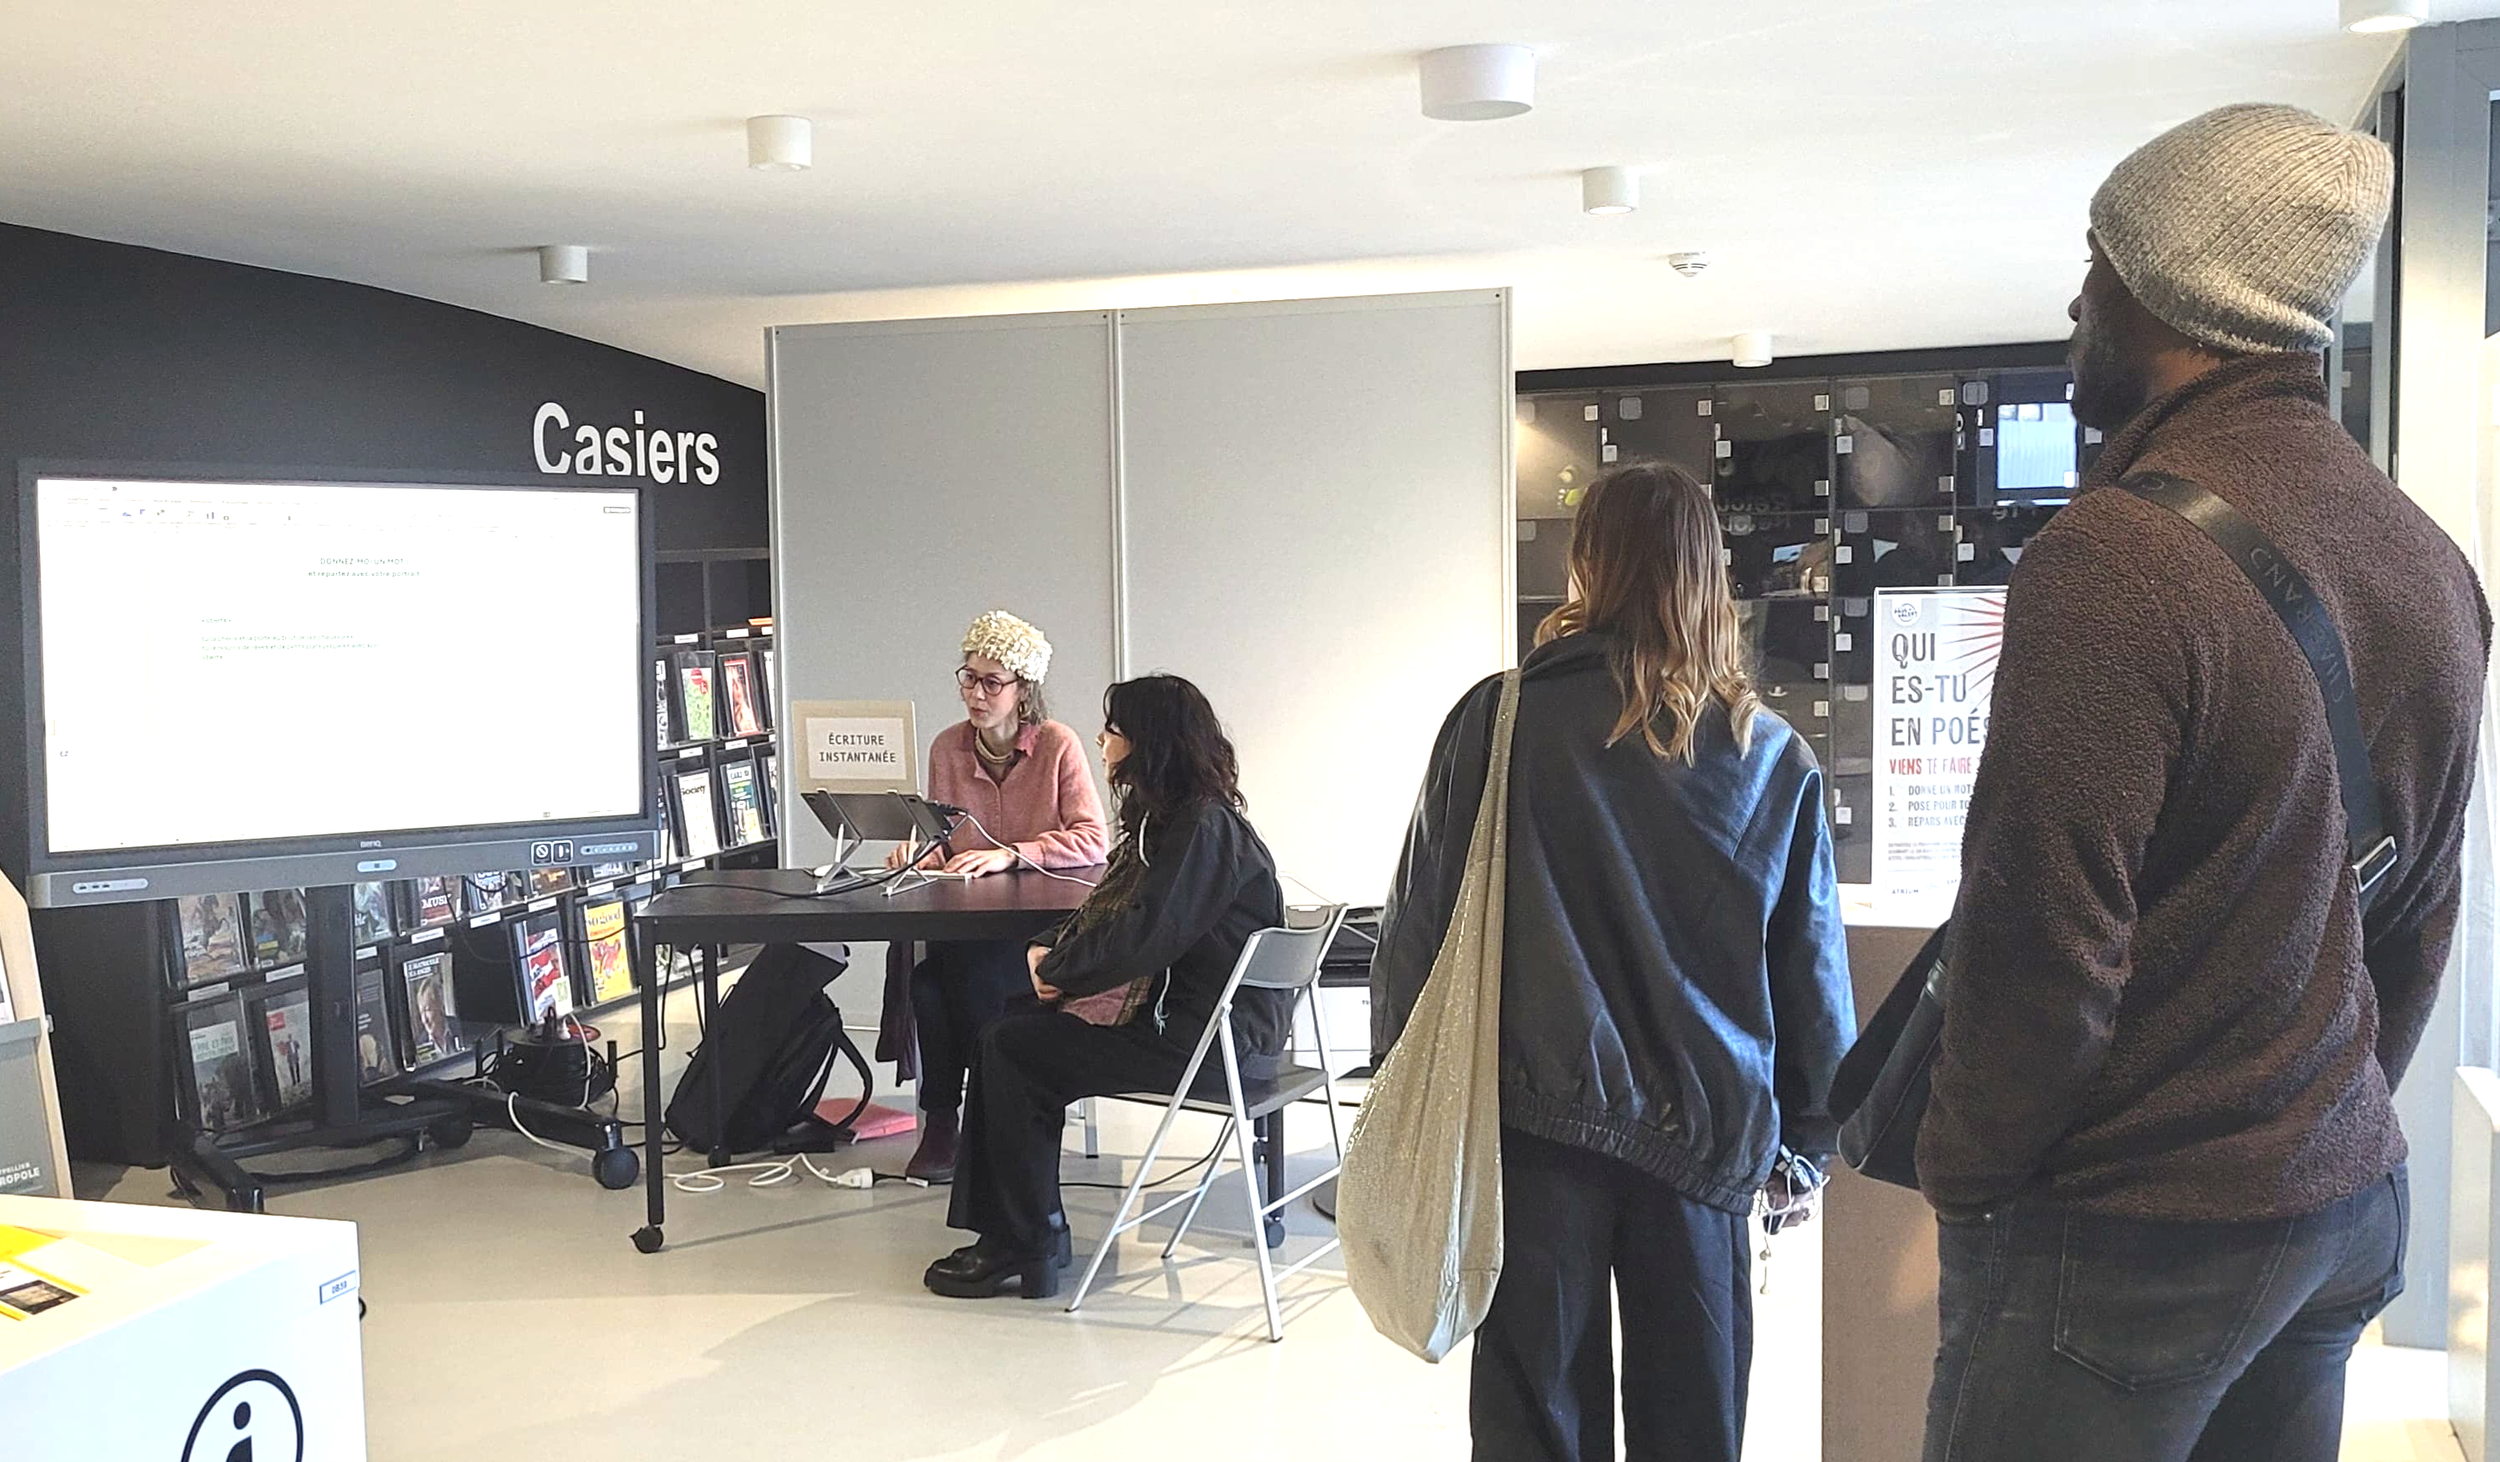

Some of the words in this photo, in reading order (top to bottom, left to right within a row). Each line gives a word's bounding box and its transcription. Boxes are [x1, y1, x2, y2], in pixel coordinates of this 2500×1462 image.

[533, 402, 720, 485] Casiers
[1892, 633, 1935, 669] QUI
[1892, 674, 1967, 704] ES-TU
[828, 732, 885, 746] ÉCRITURE
[1891, 717, 1921, 746] EN
[819, 750, 896, 763] INSTANTANÉE
[1889, 758, 1922, 775] VIENS
[1926, 758, 1937, 775] TE
[1942, 757, 1972, 774] FAIRE
[1889, 785, 1896, 796] 1.
[1908, 785, 1938, 796] DONNE
[1940, 784, 1951, 795] UN
[1954, 784, 1972, 795] MOT
[1888, 801, 1898, 812] 2.
[1908, 801, 1931, 812] POSE
[1933, 800, 1957, 811] POUR
[1888, 817, 1897, 828] 3.
[1908, 816, 1941, 827] REPARS
[1944, 815, 1965, 826] AVEC
